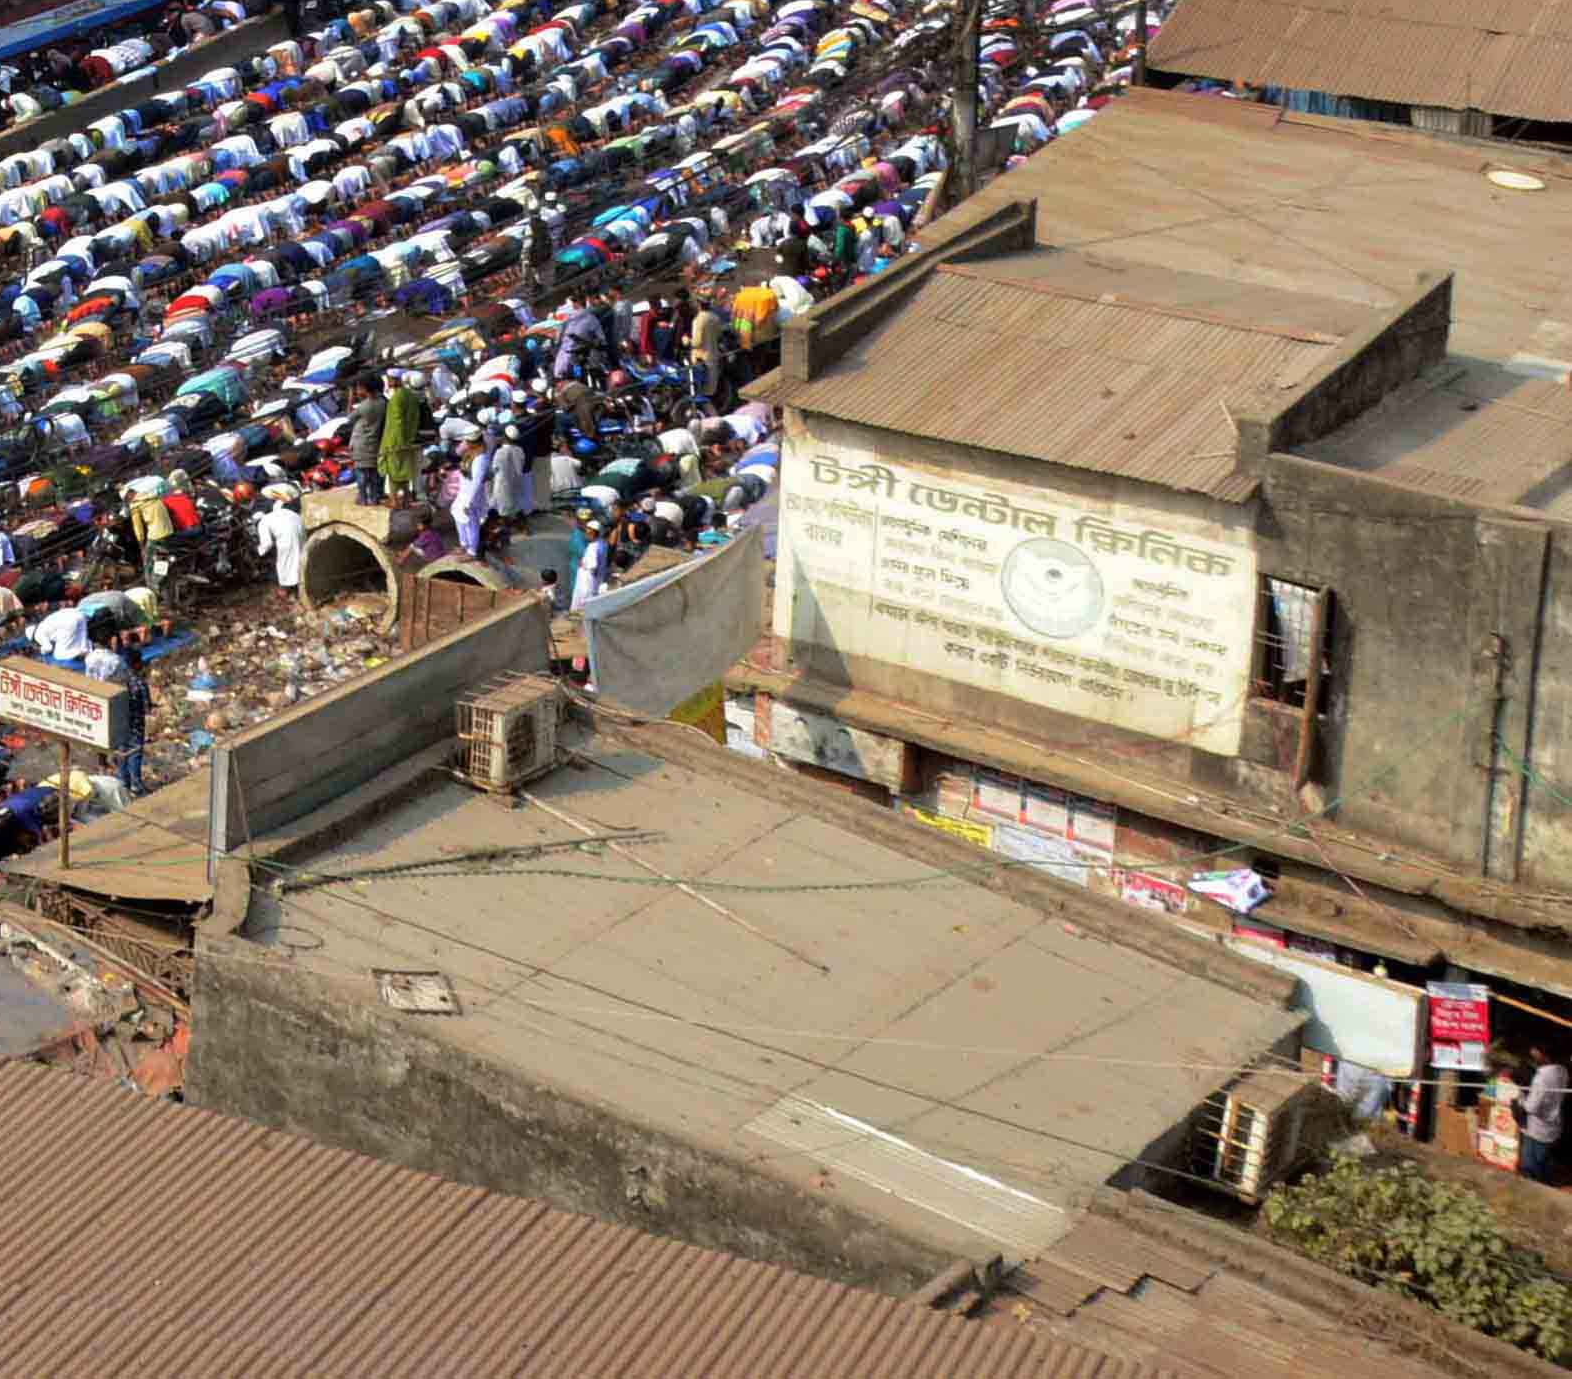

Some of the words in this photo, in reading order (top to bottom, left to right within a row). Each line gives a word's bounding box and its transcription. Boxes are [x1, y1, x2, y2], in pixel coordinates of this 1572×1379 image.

[809, 454, 899, 503] টঙ্গী
[909, 481, 1058, 542] ডেন্টাল
[1073, 515, 1236, 579] ক্লিনিক
[0, 669, 21, 698] টঙ্গী
[23, 677, 62, 709] ডেন্টাল
[64, 688, 102, 721] ক্লিনিক
